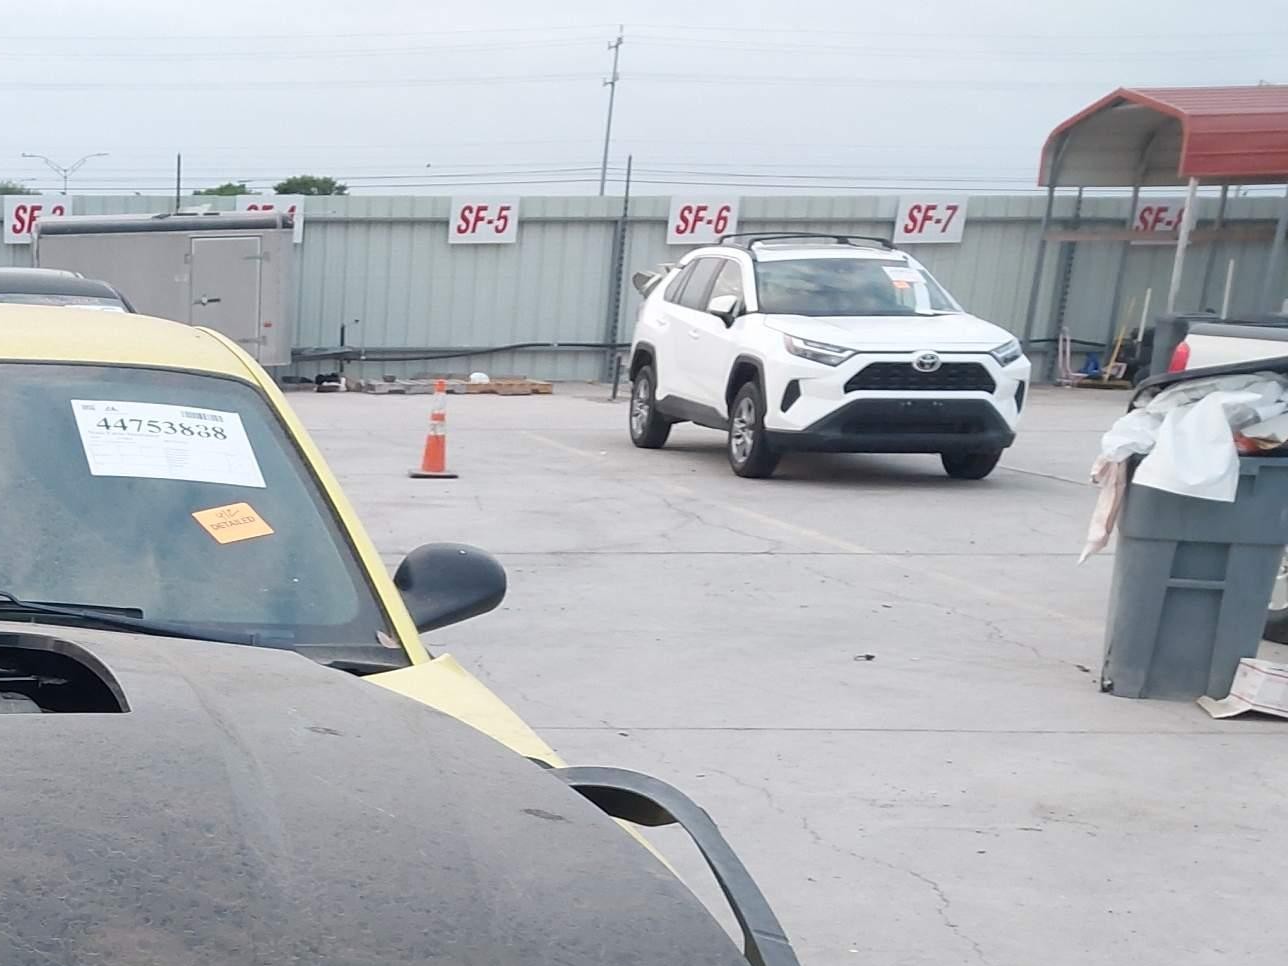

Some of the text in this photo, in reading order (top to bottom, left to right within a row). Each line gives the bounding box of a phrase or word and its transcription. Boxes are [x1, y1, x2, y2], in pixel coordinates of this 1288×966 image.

[456, 204, 512, 234] SF-5
[675, 204, 731, 235] SF-6
[903, 203, 959, 234] SF-7
